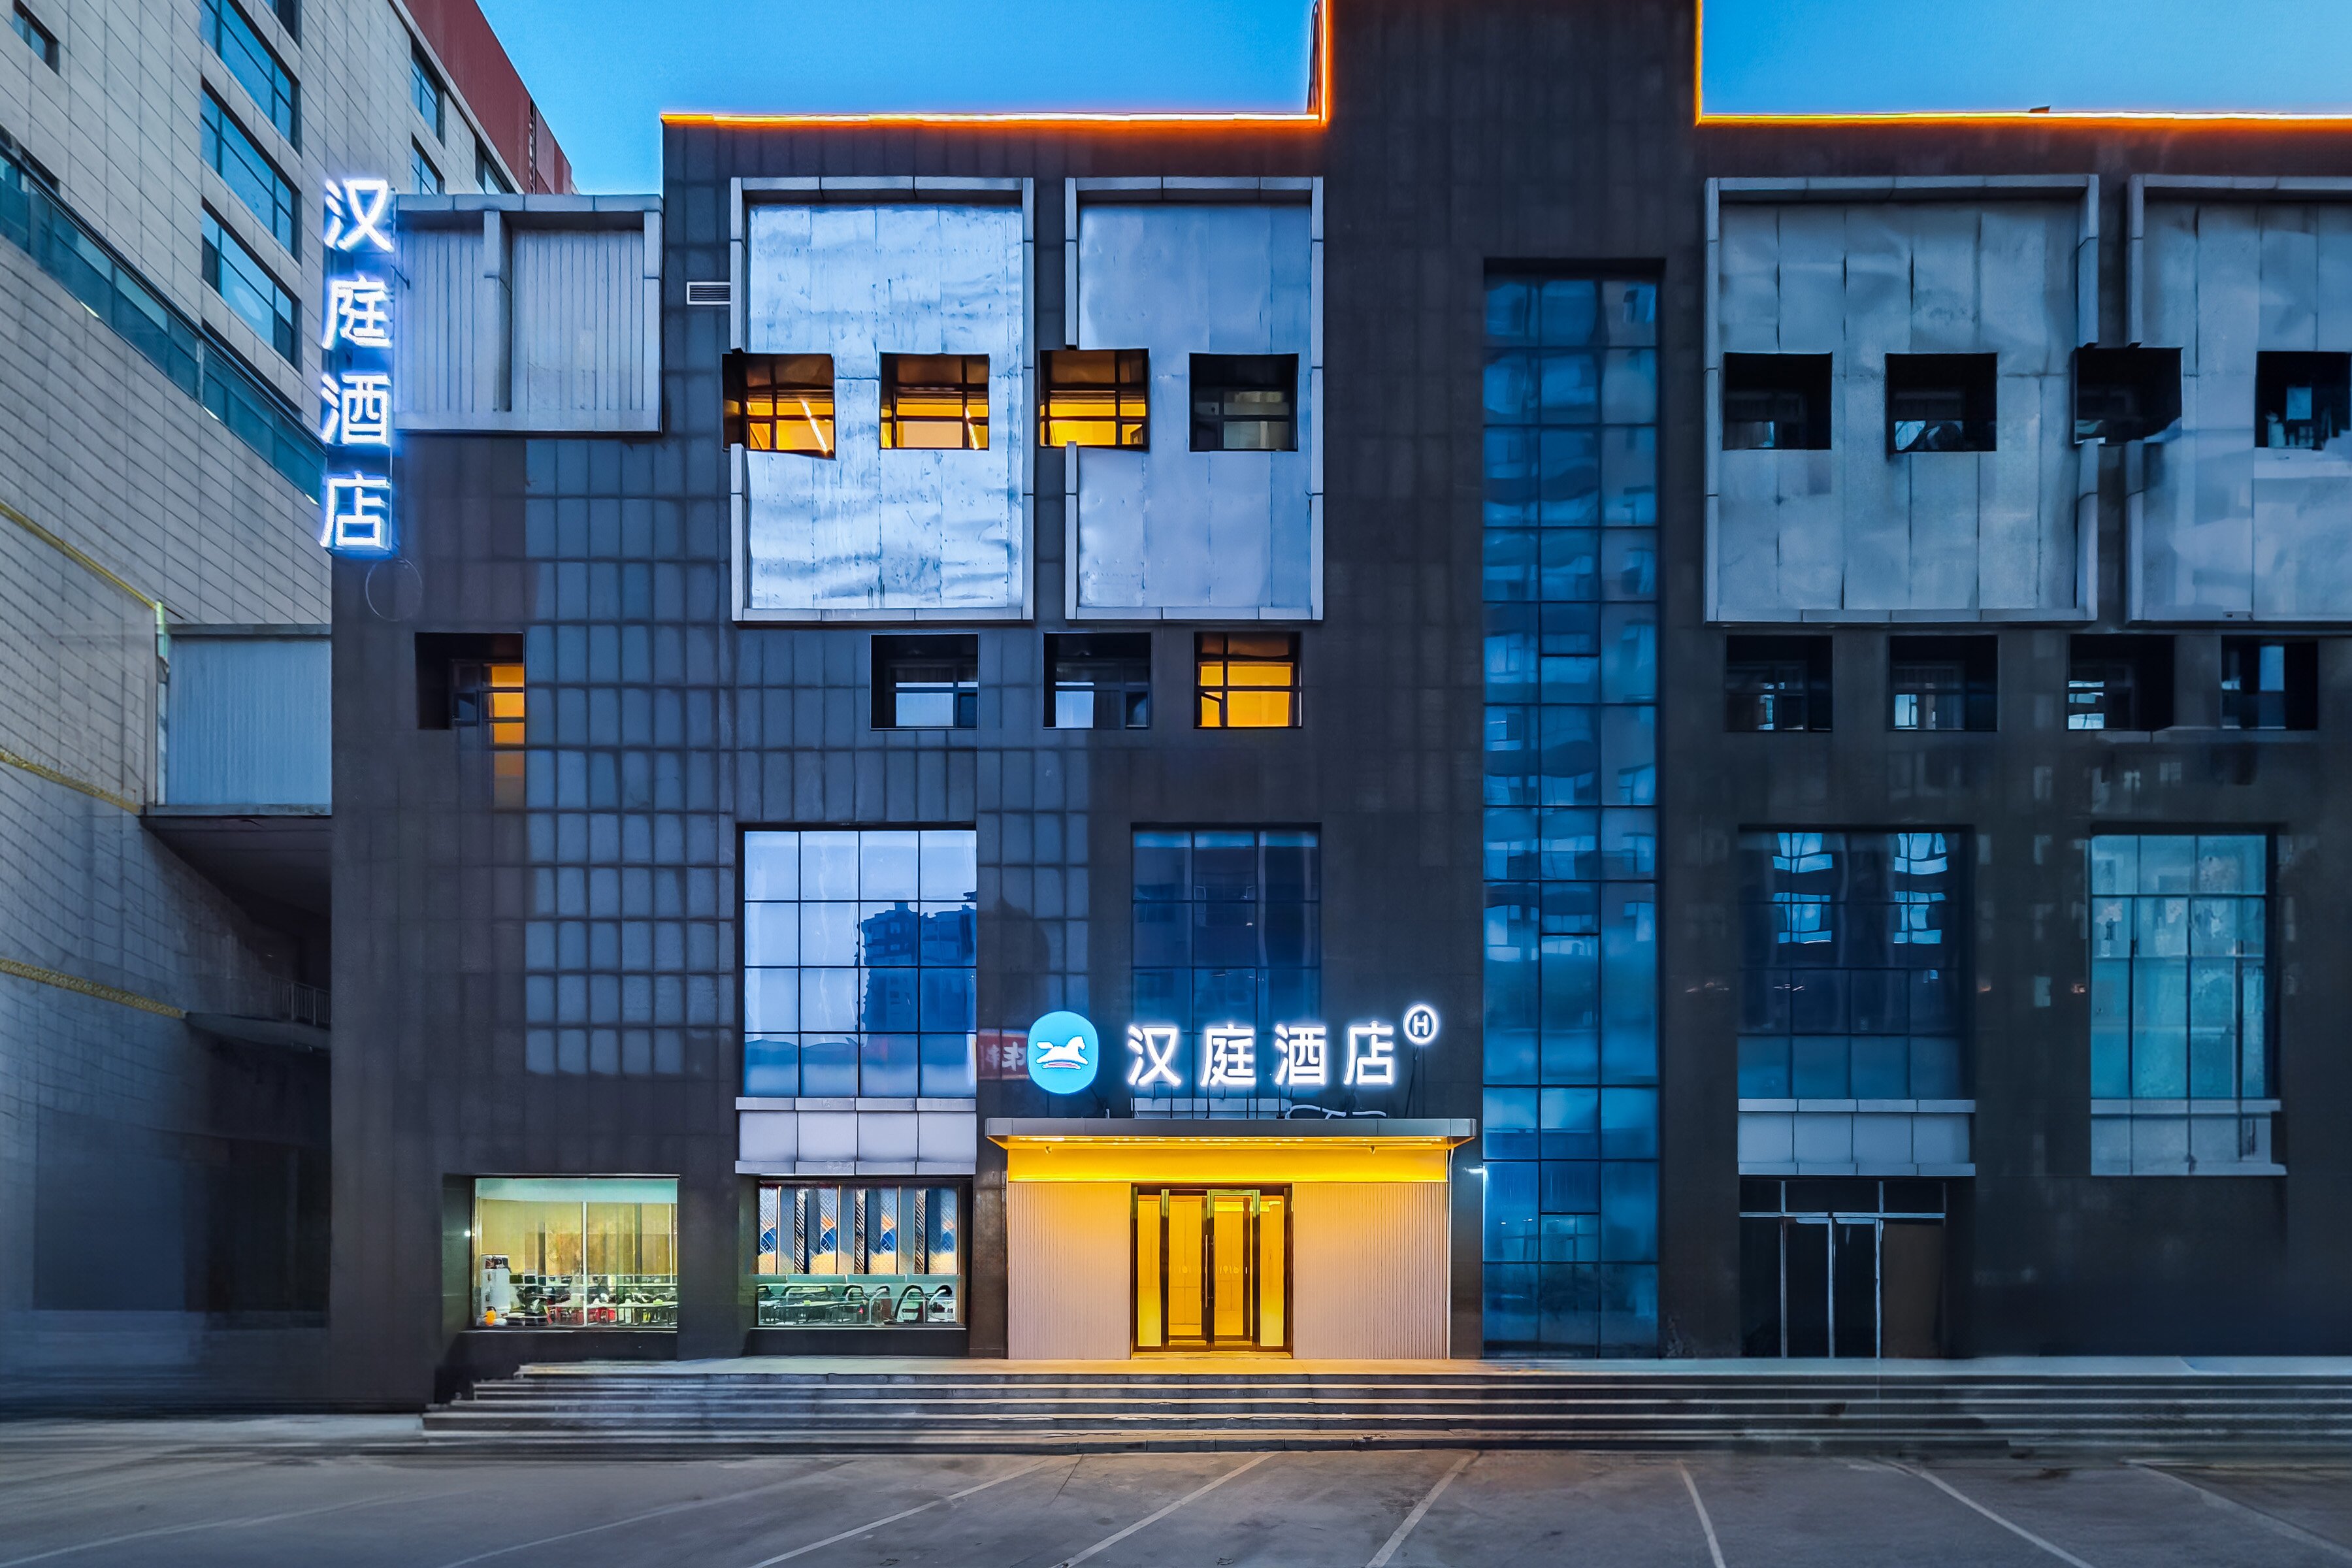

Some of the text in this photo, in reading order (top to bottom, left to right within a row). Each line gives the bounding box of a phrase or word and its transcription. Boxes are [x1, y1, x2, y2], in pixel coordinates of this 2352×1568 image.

[320, 178, 393, 549] 汉庭酒店
[1128, 1021, 1395, 1086] 汉庭酒店
